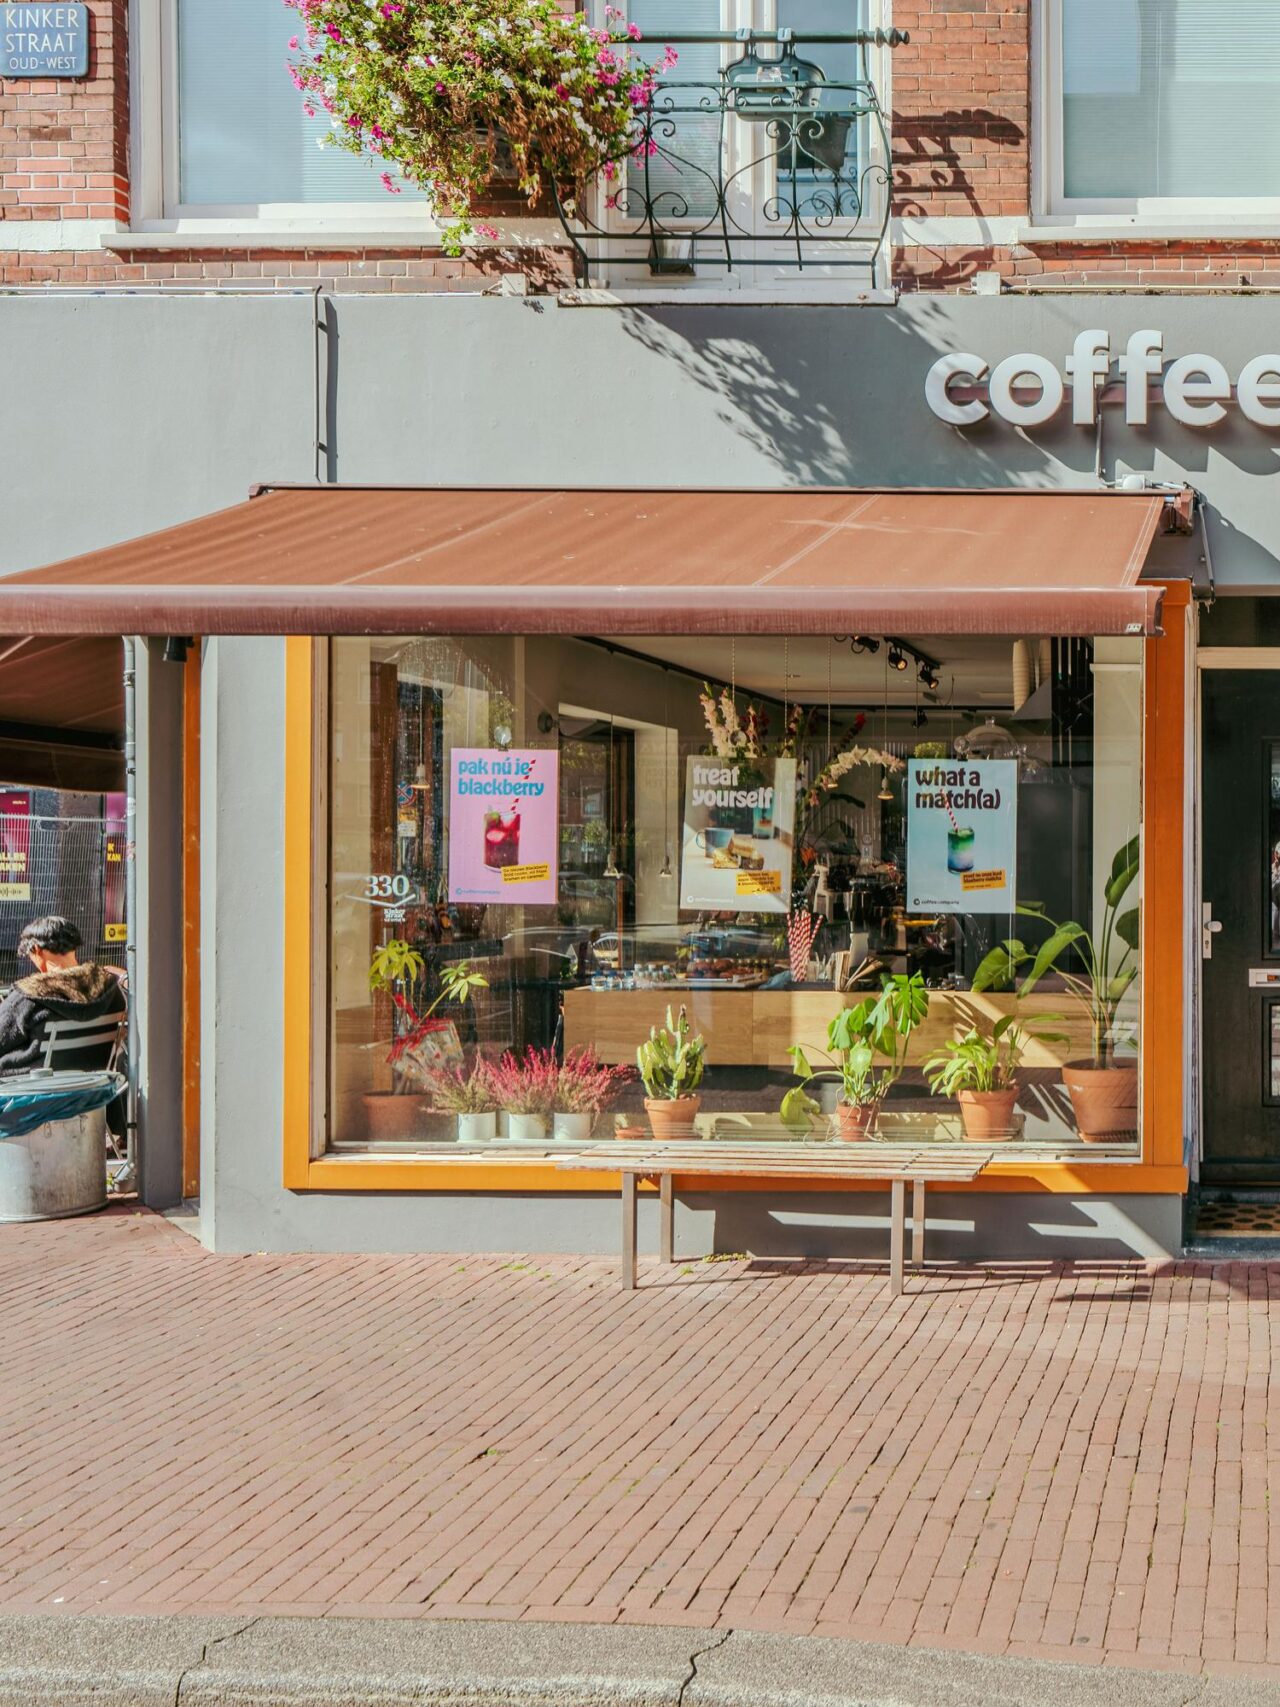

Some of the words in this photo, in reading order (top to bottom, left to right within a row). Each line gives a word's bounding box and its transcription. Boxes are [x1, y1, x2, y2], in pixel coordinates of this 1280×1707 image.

[6, 8, 79, 28] KINKER
[6, 33, 77, 53] STRAAT
[9, 56, 77, 70] OUD-WEST
[458, 757, 488, 776] pak
[492, 757, 512, 775] nú
[515, 758, 530, 775] je
[693, 765, 740, 786] treat
[915, 766, 966, 786] what
[969, 770, 980, 786] a
[458, 778, 544, 796] blackberry
[692, 787, 773, 809] yourself
[915, 788, 1001, 809] match(a)
[365, 874, 409, 897] 330
